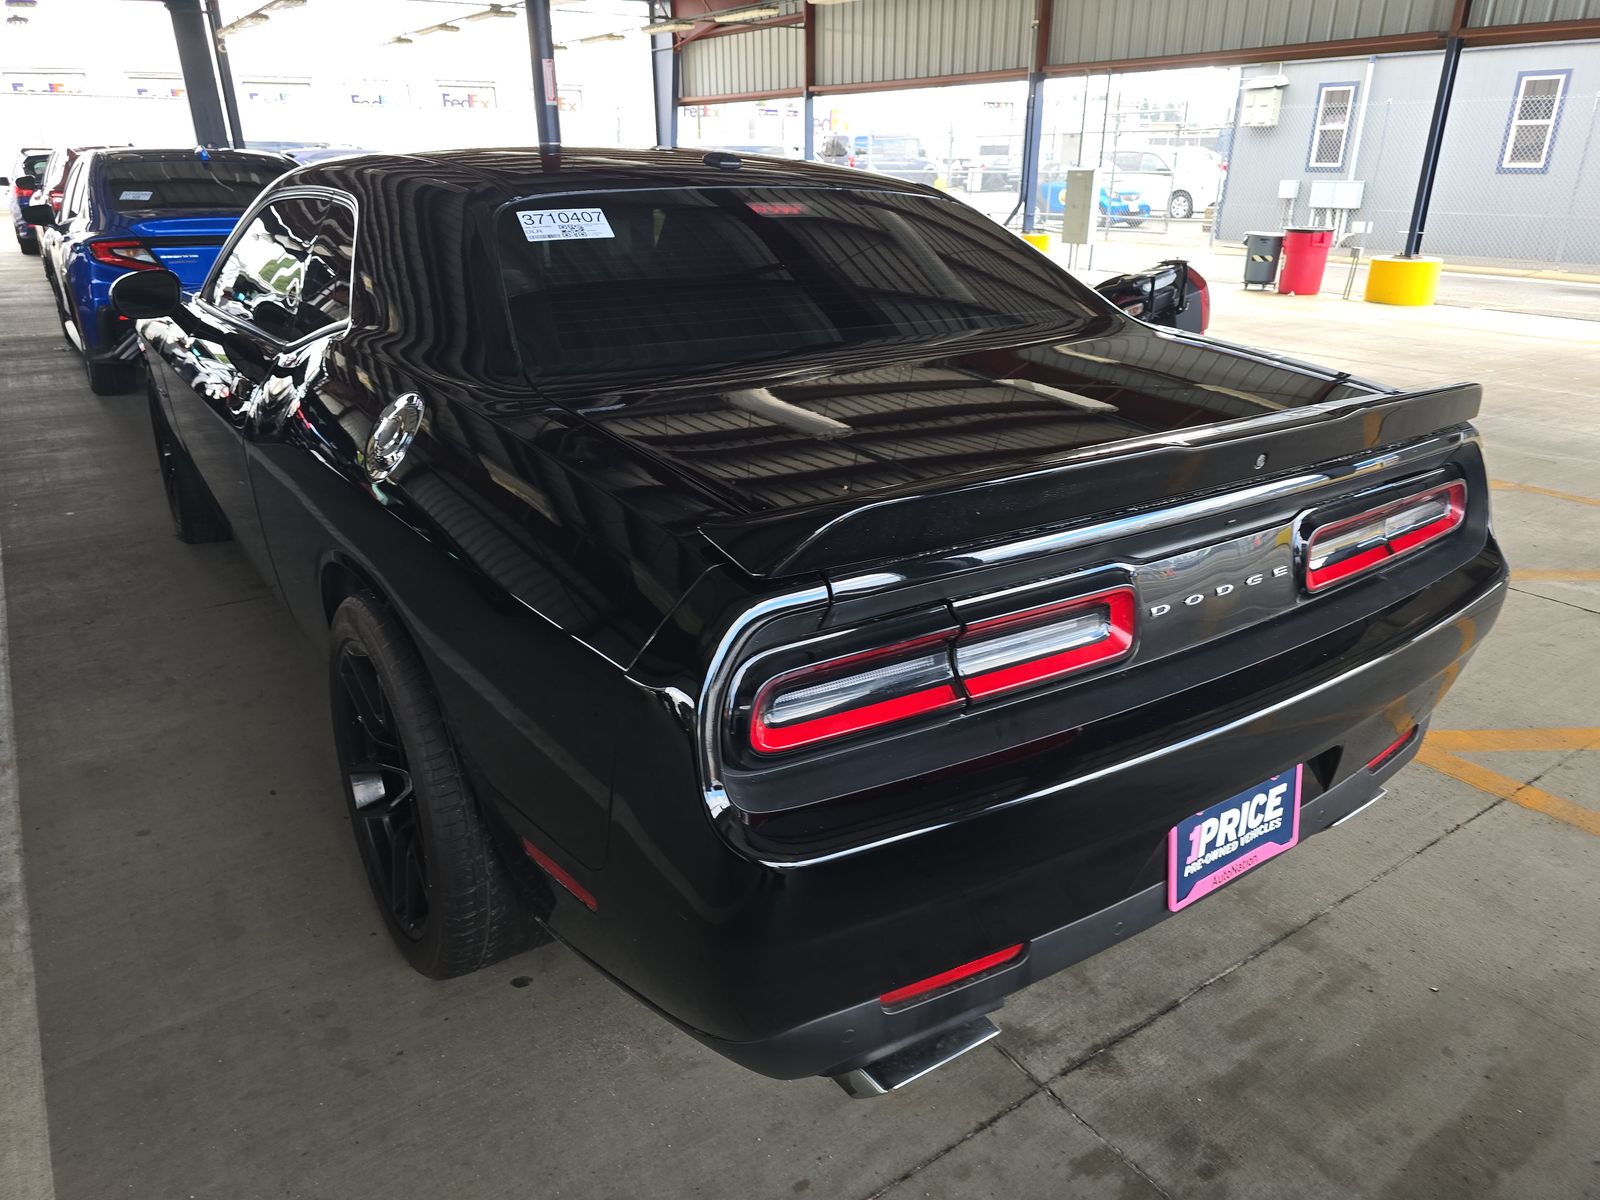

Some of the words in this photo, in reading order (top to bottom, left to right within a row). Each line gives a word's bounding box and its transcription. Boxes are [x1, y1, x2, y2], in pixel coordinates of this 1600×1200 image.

[522, 211, 601, 226] 3710407
[1150, 565, 1289, 617] DODGE
[1183, 839, 1239, 878] PRE-OWNED
[1239, 817, 1283, 847] VEHICLES
[1211, 855, 1258, 888] AutoNation
